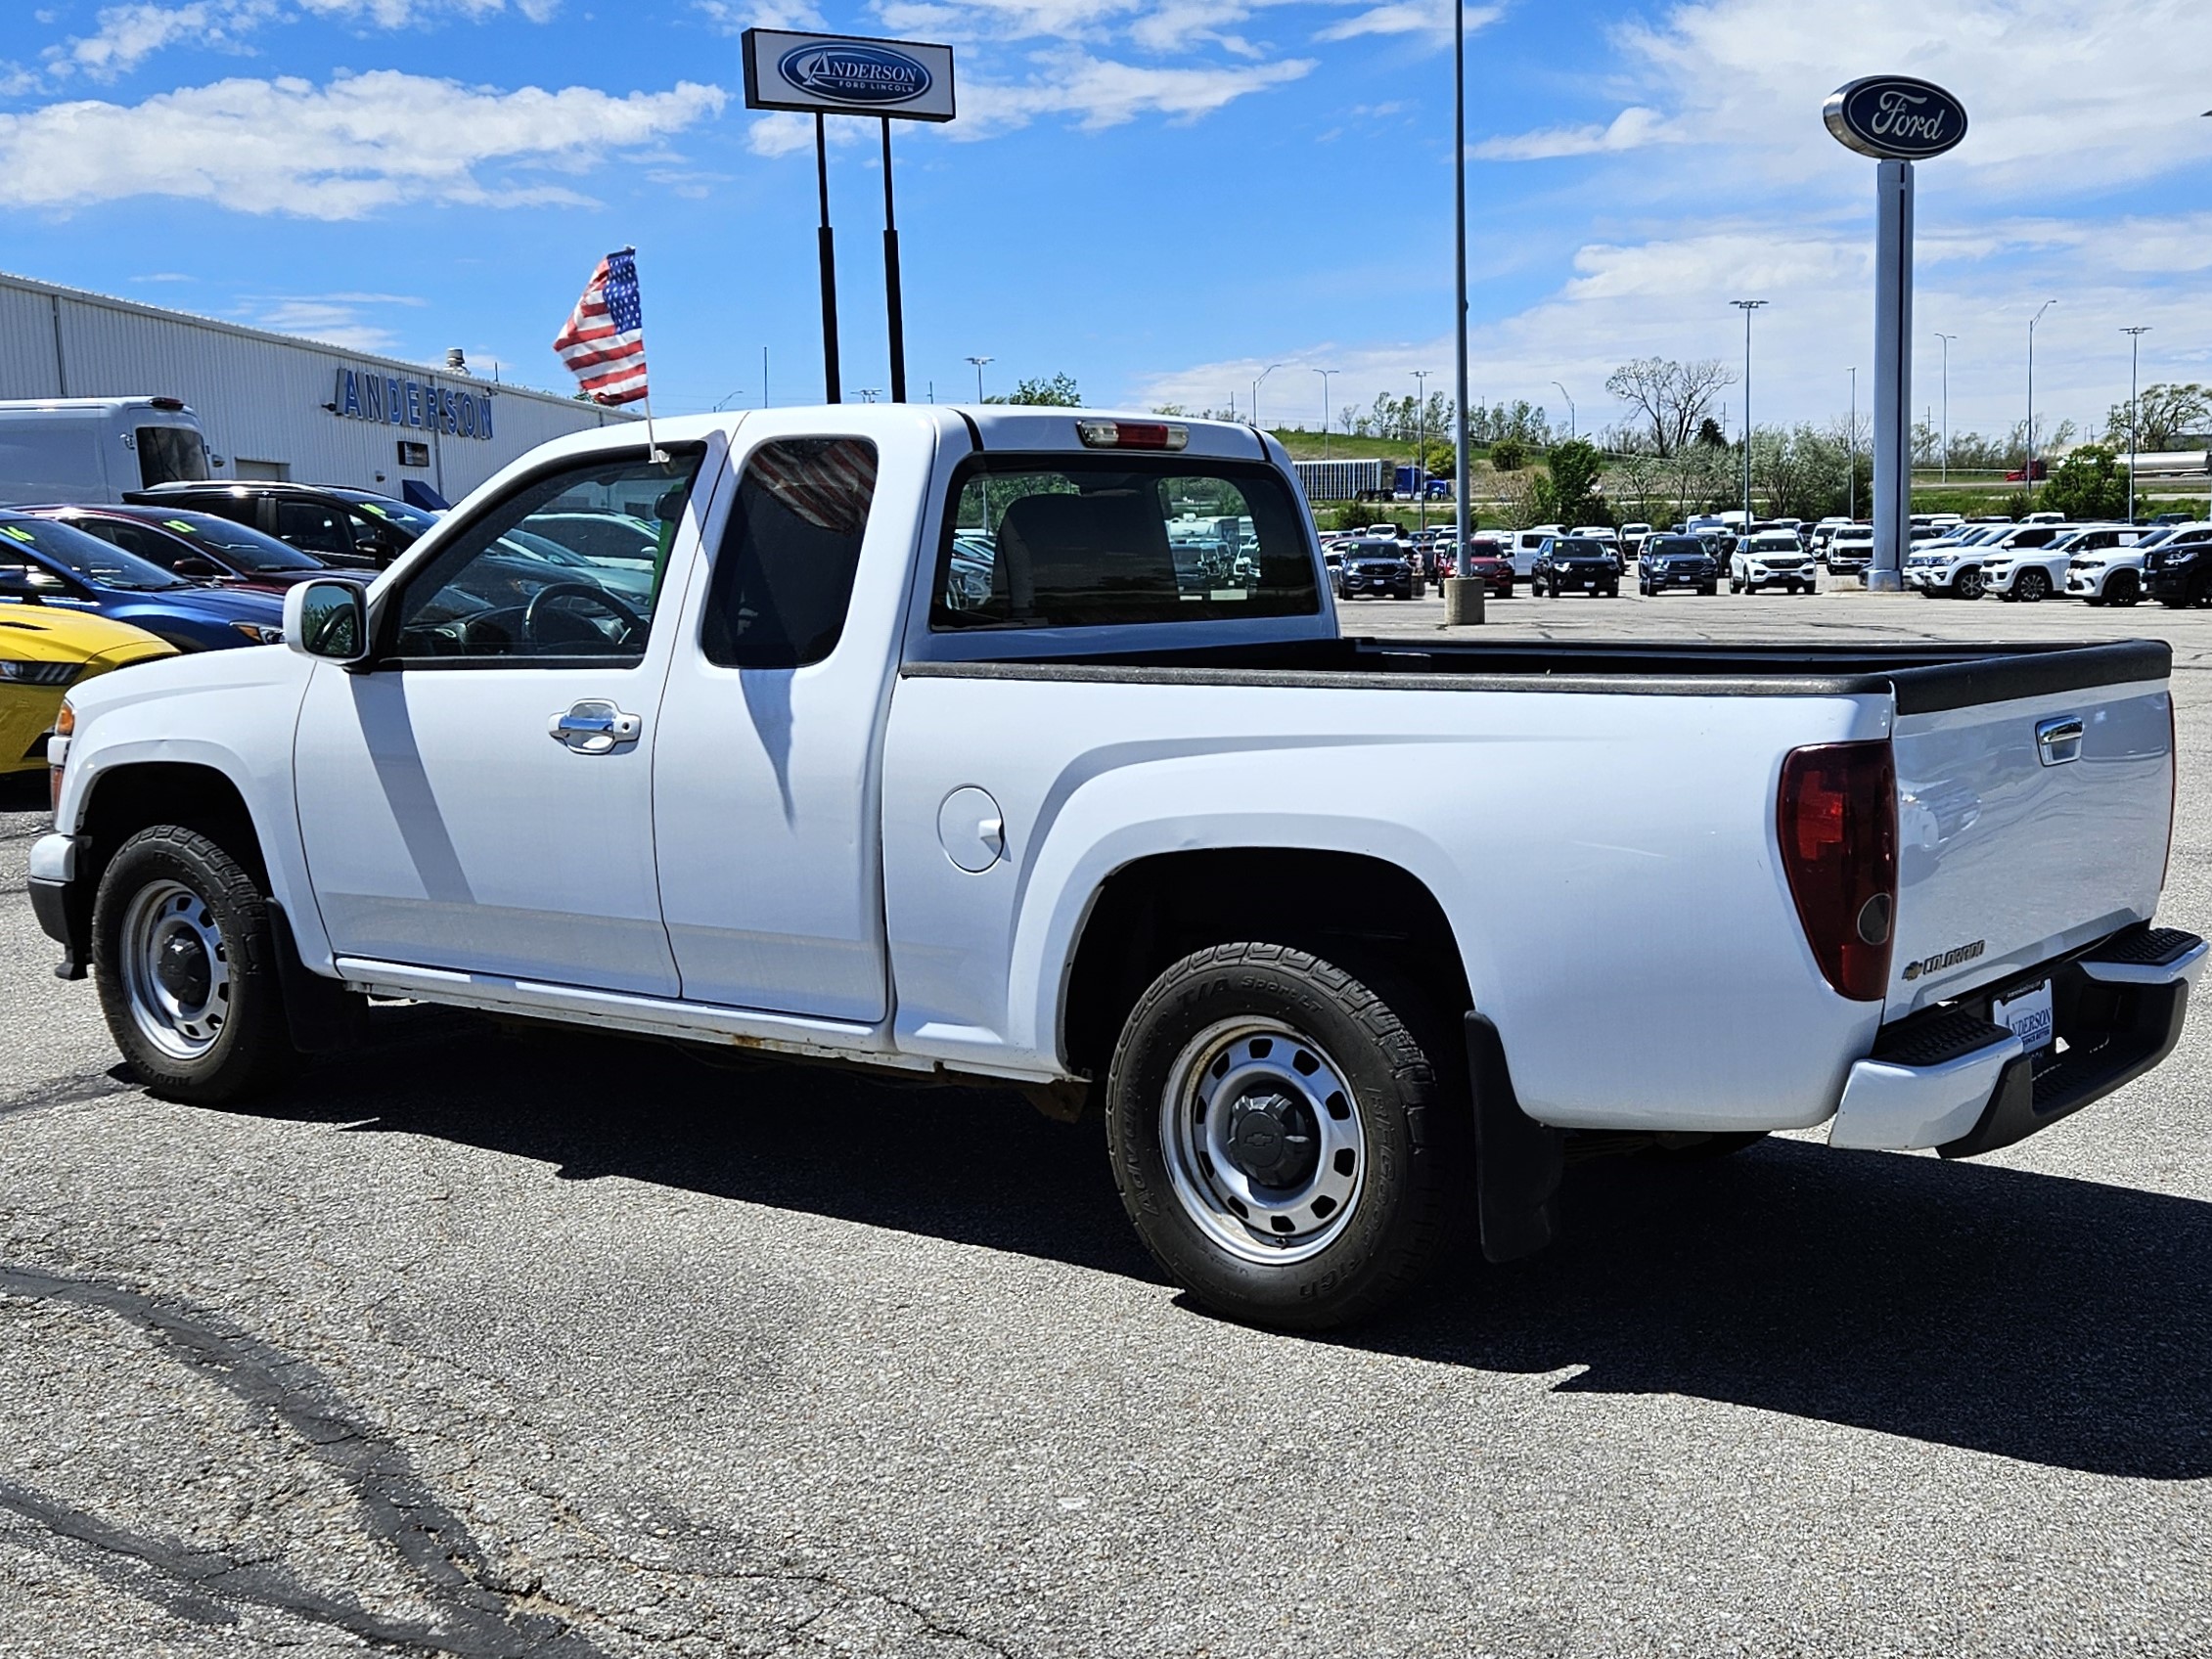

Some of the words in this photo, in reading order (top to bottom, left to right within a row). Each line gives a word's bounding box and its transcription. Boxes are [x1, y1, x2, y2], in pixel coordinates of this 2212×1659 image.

[802, 51, 918, 86] ANDERSON
[838, 80, 866, 90] FORD
[871, 82, 914, 93] LINCOLN
[1871, 90, 1946, 141] Ford
[339, 369, 493, 440] ANDERSON
[1922, 939, 1985, 975] COLORADO
[1240, 975, 1297, 1000] Sport
